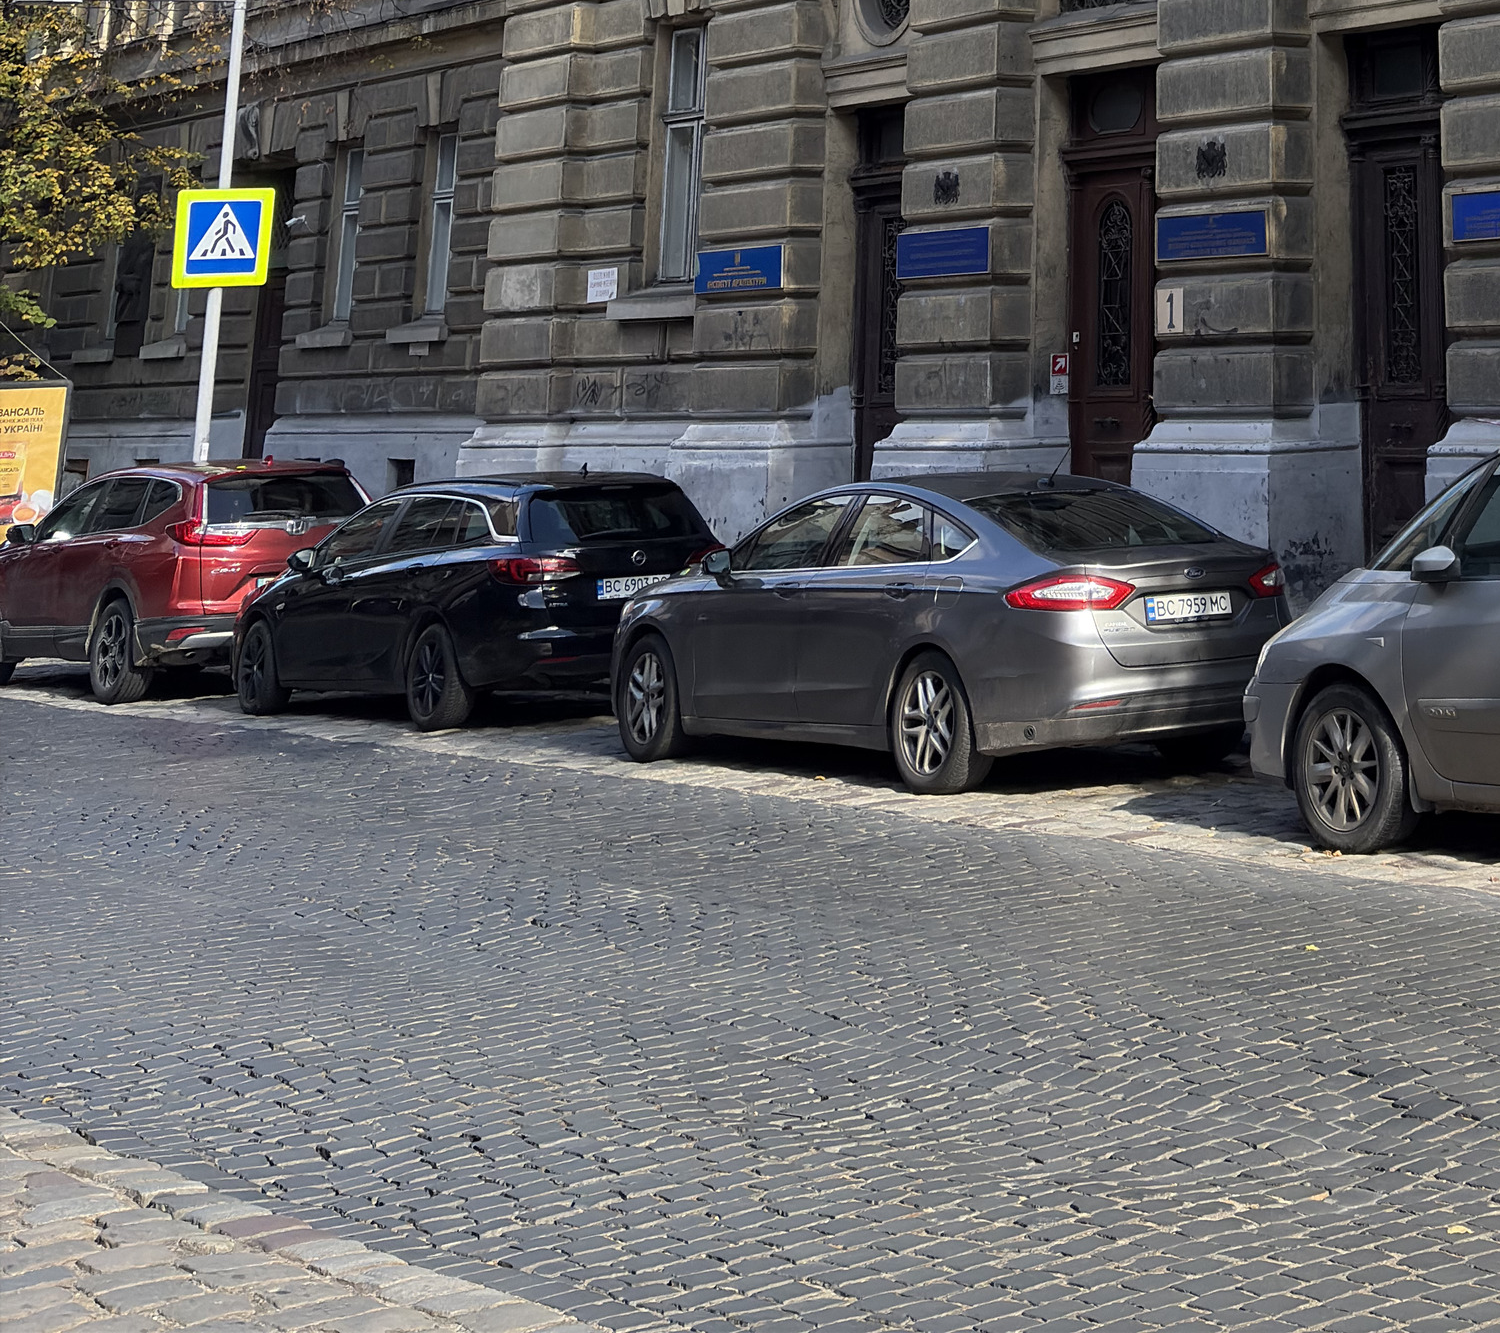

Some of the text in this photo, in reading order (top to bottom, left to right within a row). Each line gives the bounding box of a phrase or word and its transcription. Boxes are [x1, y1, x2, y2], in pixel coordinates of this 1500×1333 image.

[1166, 292, 1176, 329] 1
[4, 423, 43, 434] УКРАЇНІ
[604, 580, 621, 593] BC
[1156, 595, 1228, 616] BC 7959 MC
